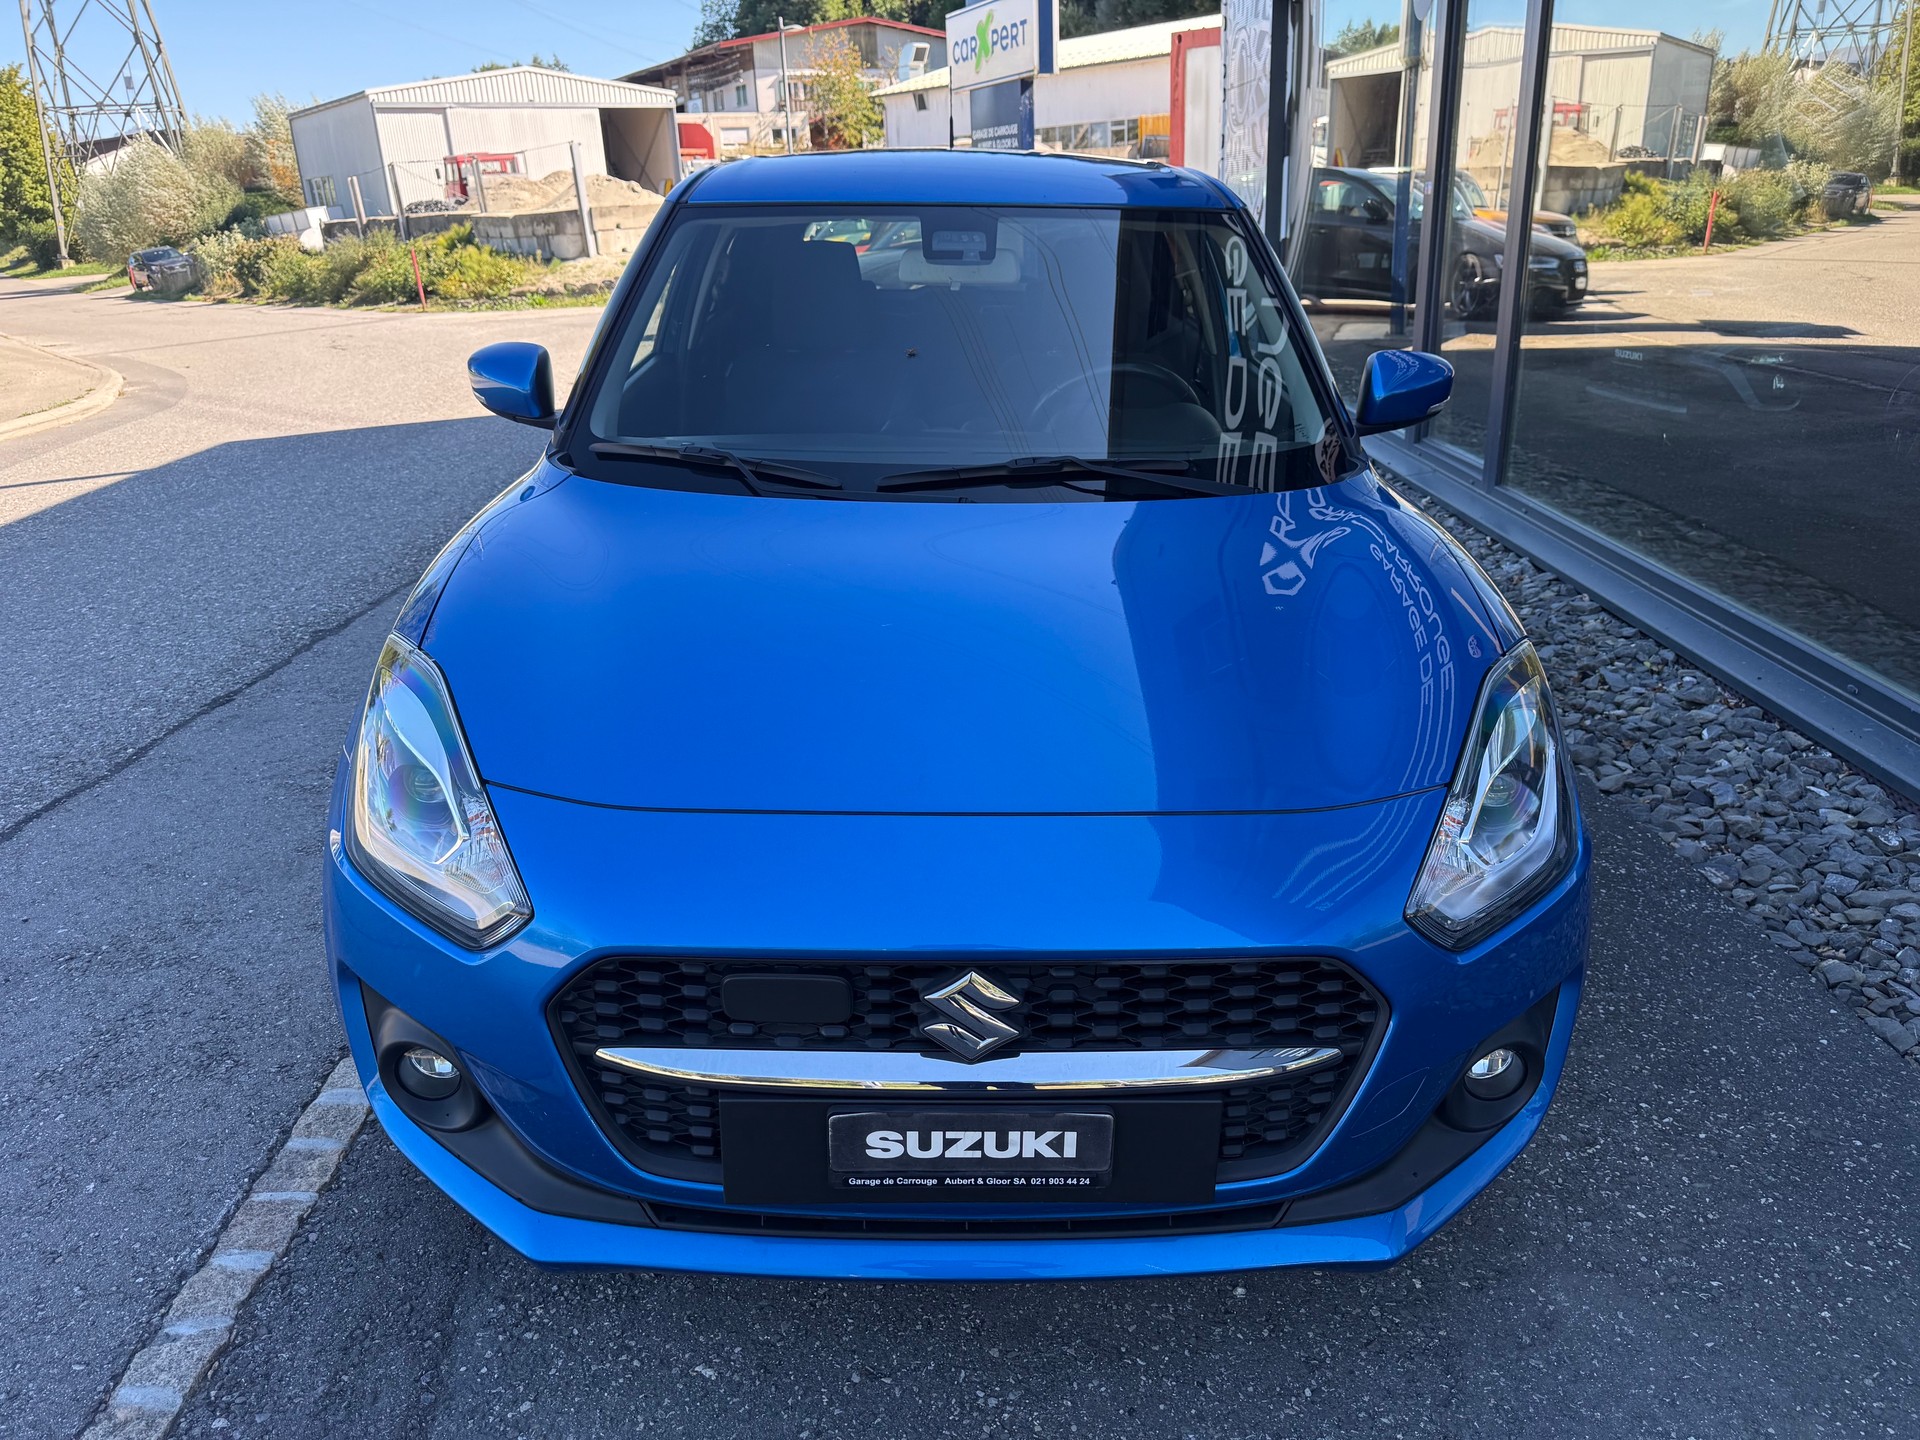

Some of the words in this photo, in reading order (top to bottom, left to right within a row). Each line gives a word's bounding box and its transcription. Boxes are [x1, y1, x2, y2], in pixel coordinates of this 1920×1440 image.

[1615, 349, 1643, 361] SUZUKI
[865, 1130, 1078, 1159] SUZUKI
[848, 1177, 881, 1187] Garage
[883, 1177, 895, 1185] de
[896, 1176, 938, 1186] Carrouge
[944, 1177, 975, 1185] Aubert
[976, 1177, 984, 1185] &
[986, 1177, 1012, 1185] Gloor
[1013, 1177, 1027, 1185] SA
[1030, 1177, 1046, 1185] 021
[1048, 1177, 1065, 1185] 903
[1066, 1177, 1078, 1185] 44
[1079, 1177, 1091, 1185] 24
